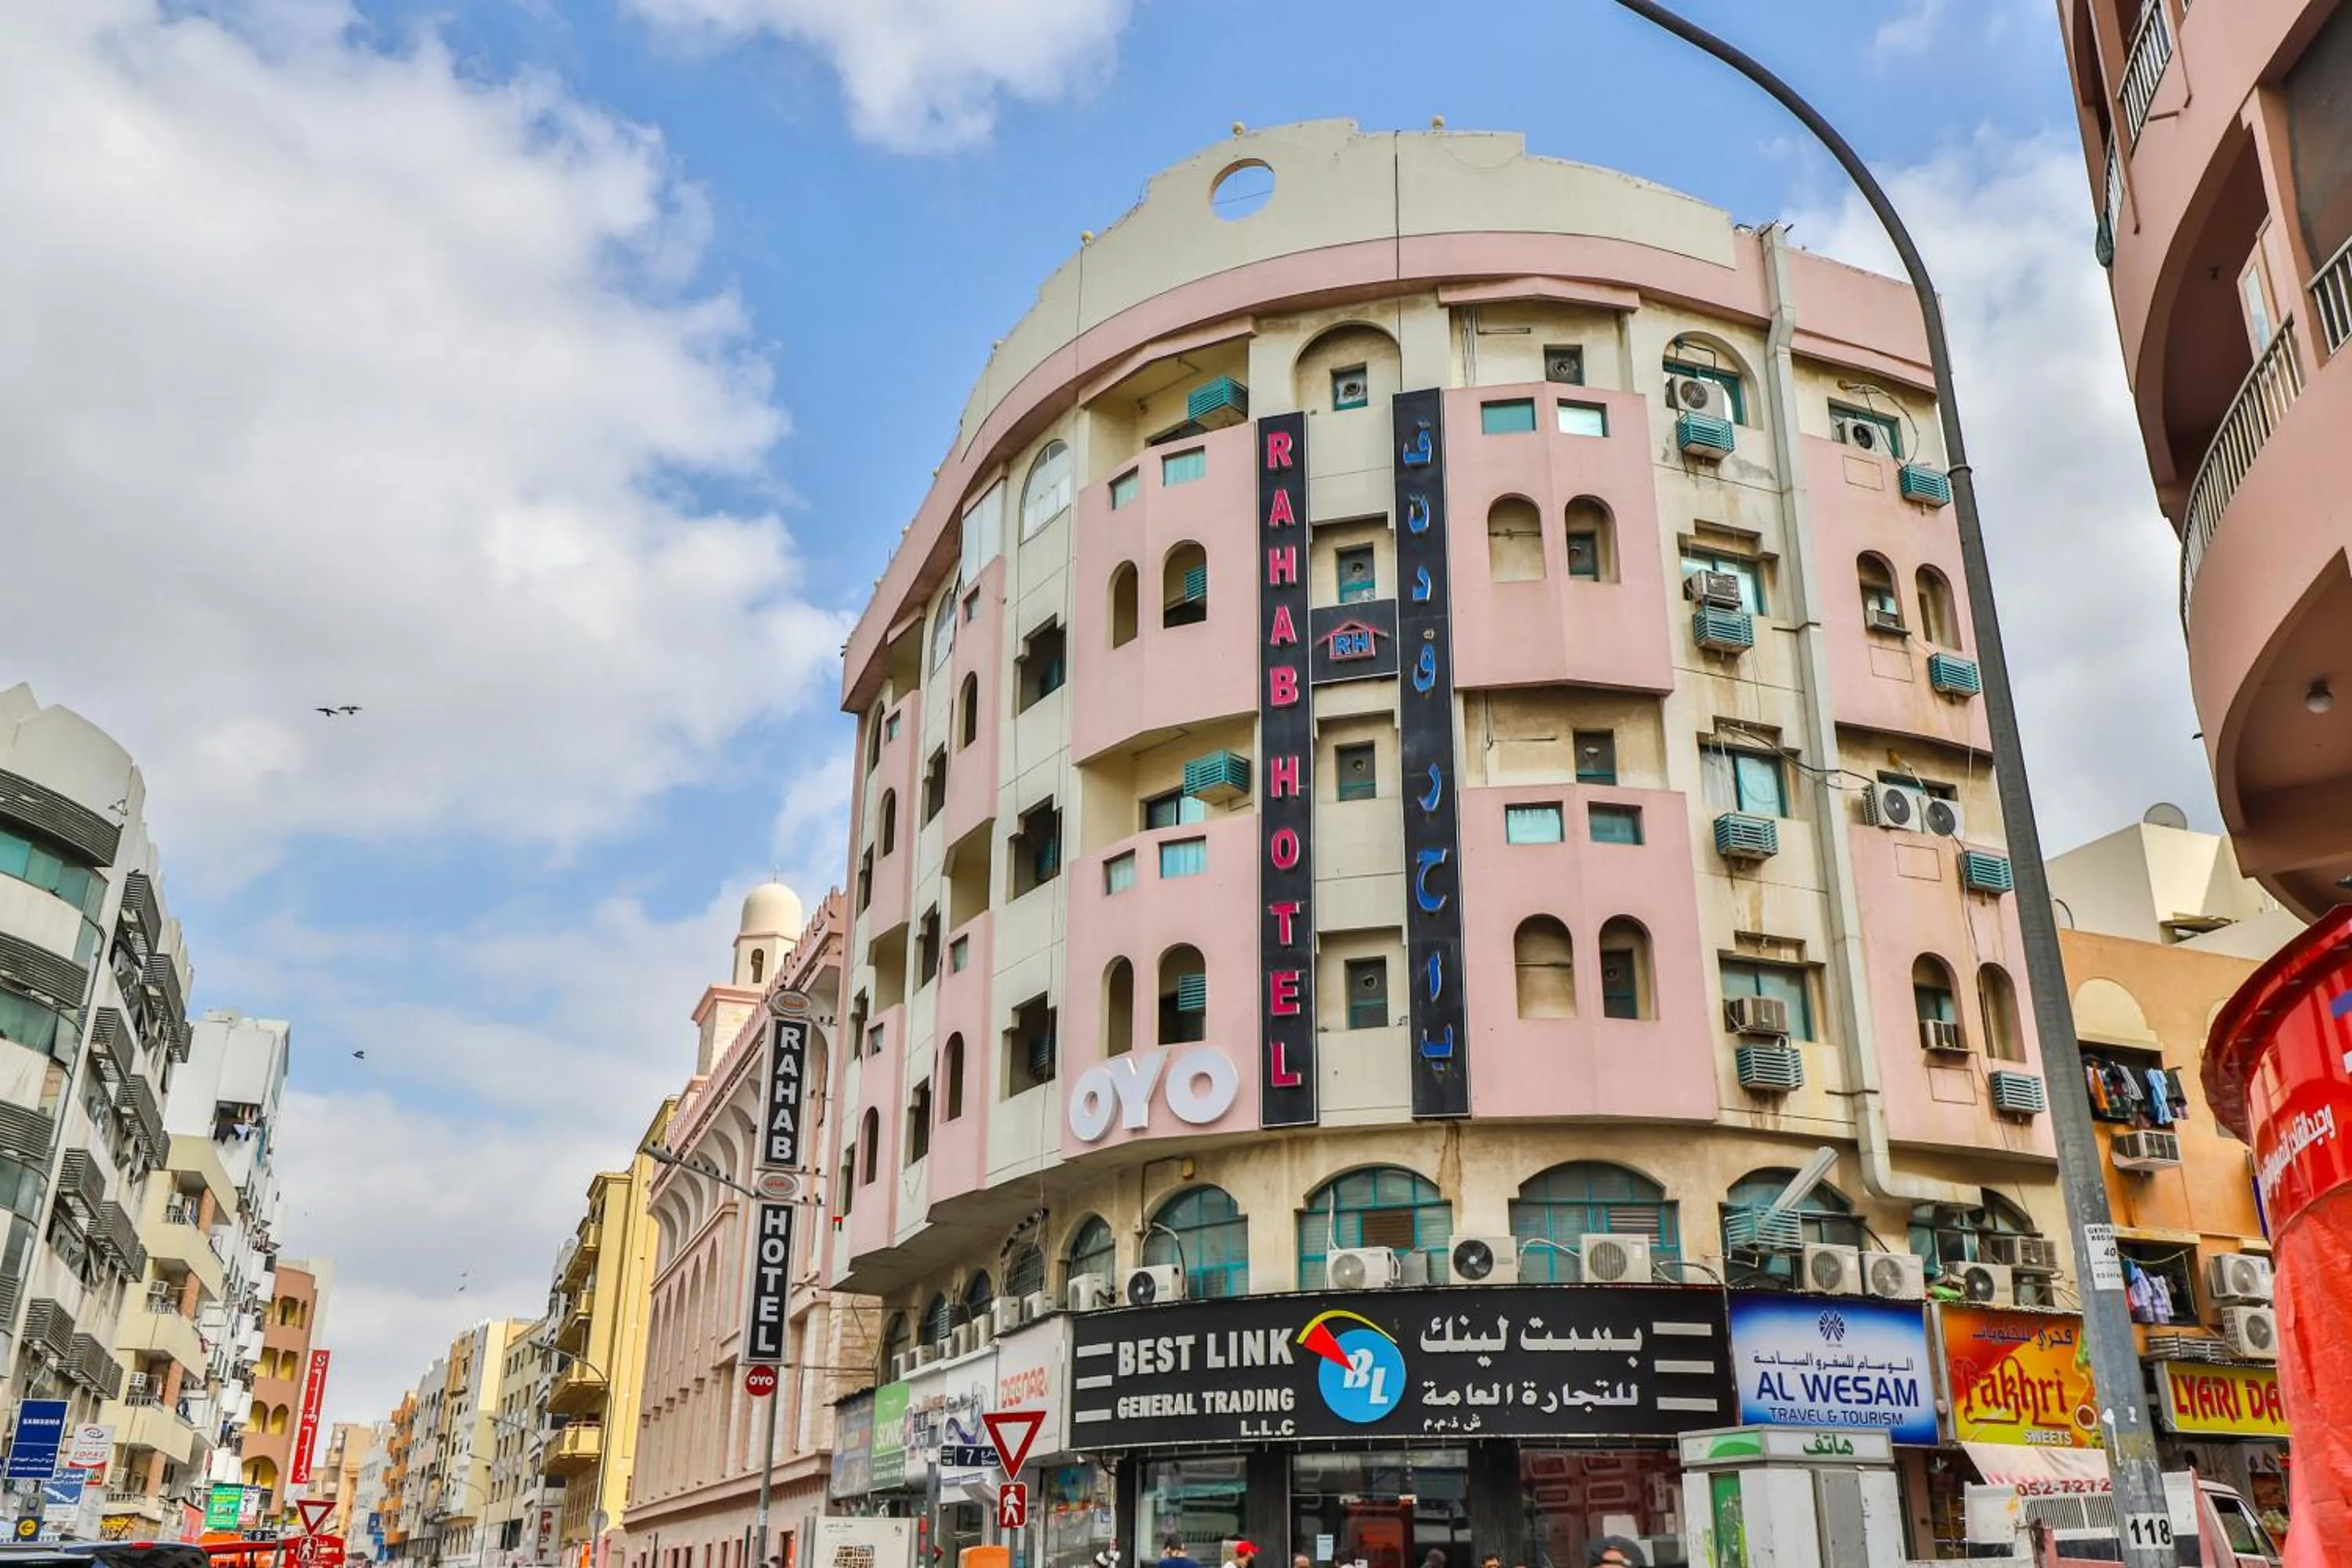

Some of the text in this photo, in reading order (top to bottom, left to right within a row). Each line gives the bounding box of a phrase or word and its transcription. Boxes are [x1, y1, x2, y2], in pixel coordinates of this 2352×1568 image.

[1334, 630, 1370, 655] RH
[1266, 430, 1302, 1089] RAHAB HOTEL
[771, 1026, 801, 1160] RAHAB
[1069, 1046, 1240, 1142] OYO
[757, 1209, 788, 1353] HOTEL
[1118, 1328, 1294, 1376] BEST LINK
[1520, 1316, 1642, 1367] بست
[749, 1376, 774, 1386] OYO
[1343, 1348, 1388, 1404] BL
[1757, 1371, 1919, 1407] AL WESAM
[1118, 1388, 1295, 1420] GENERAL TRADING
[1421, 1379, 1638, 1413] للتجارة العامة
[2171, 1374, 2285, 1426] LYARI DA
[1240, 1419, 1295, 1436] L.L.C
[1769, 1407, 1823, 1423] TRAVEL
[1841, 1410, 1904, 1425] TOURISM
[1803, 1432, 1854, 1456] هاتف
[2024, 1429, 2072, 1445] SWEETS
[965, 1448, 975, 1465] 7
[2130, 1518, 2172, 1545] 118
